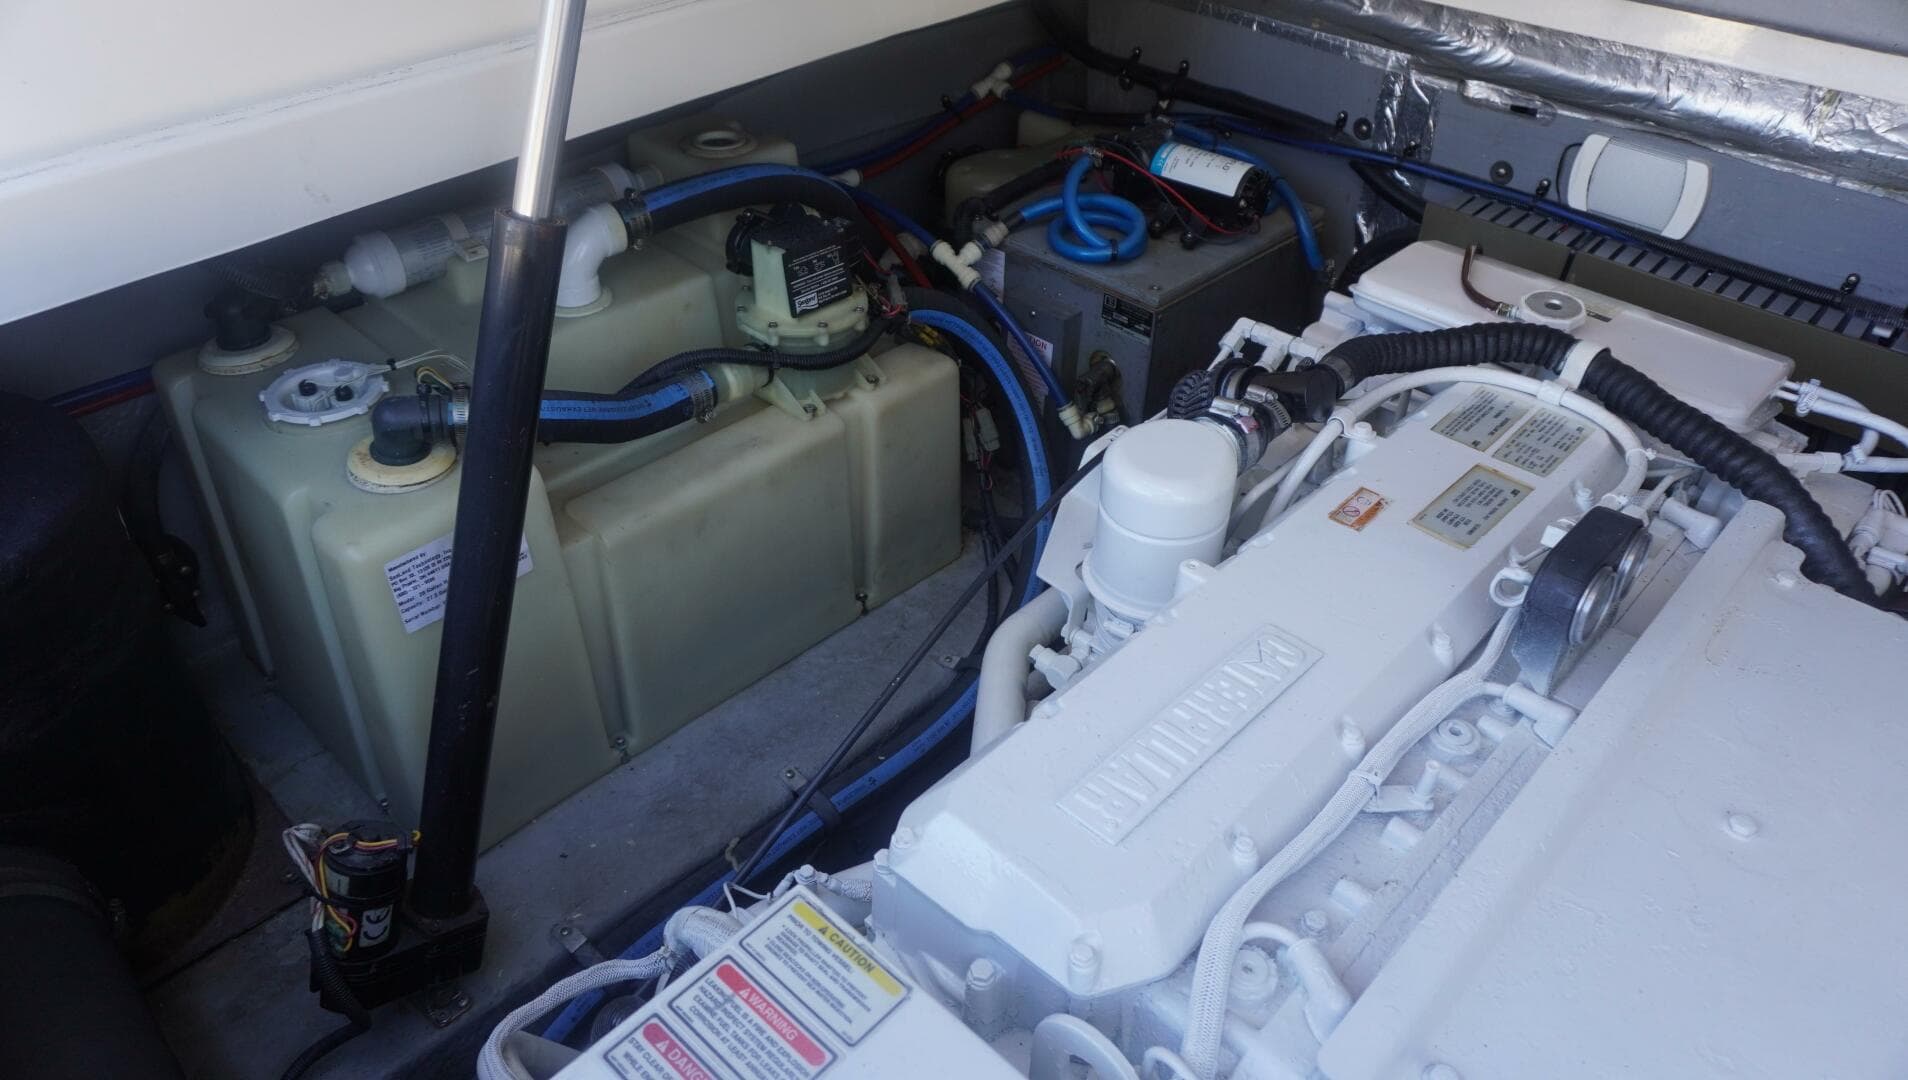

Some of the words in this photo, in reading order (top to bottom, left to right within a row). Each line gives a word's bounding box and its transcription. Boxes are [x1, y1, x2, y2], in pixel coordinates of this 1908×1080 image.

[1073, 639, 1306, 830] CATERPILLAR
[826, 931, 877, 973] CAUTION
[746, 992, 799, 1042] WARNING
[627, 1036, 646, 1054] STAY
[640, 1050, 665, 1074] CLEAR
[666, 1047, 709, 1080] DANG
